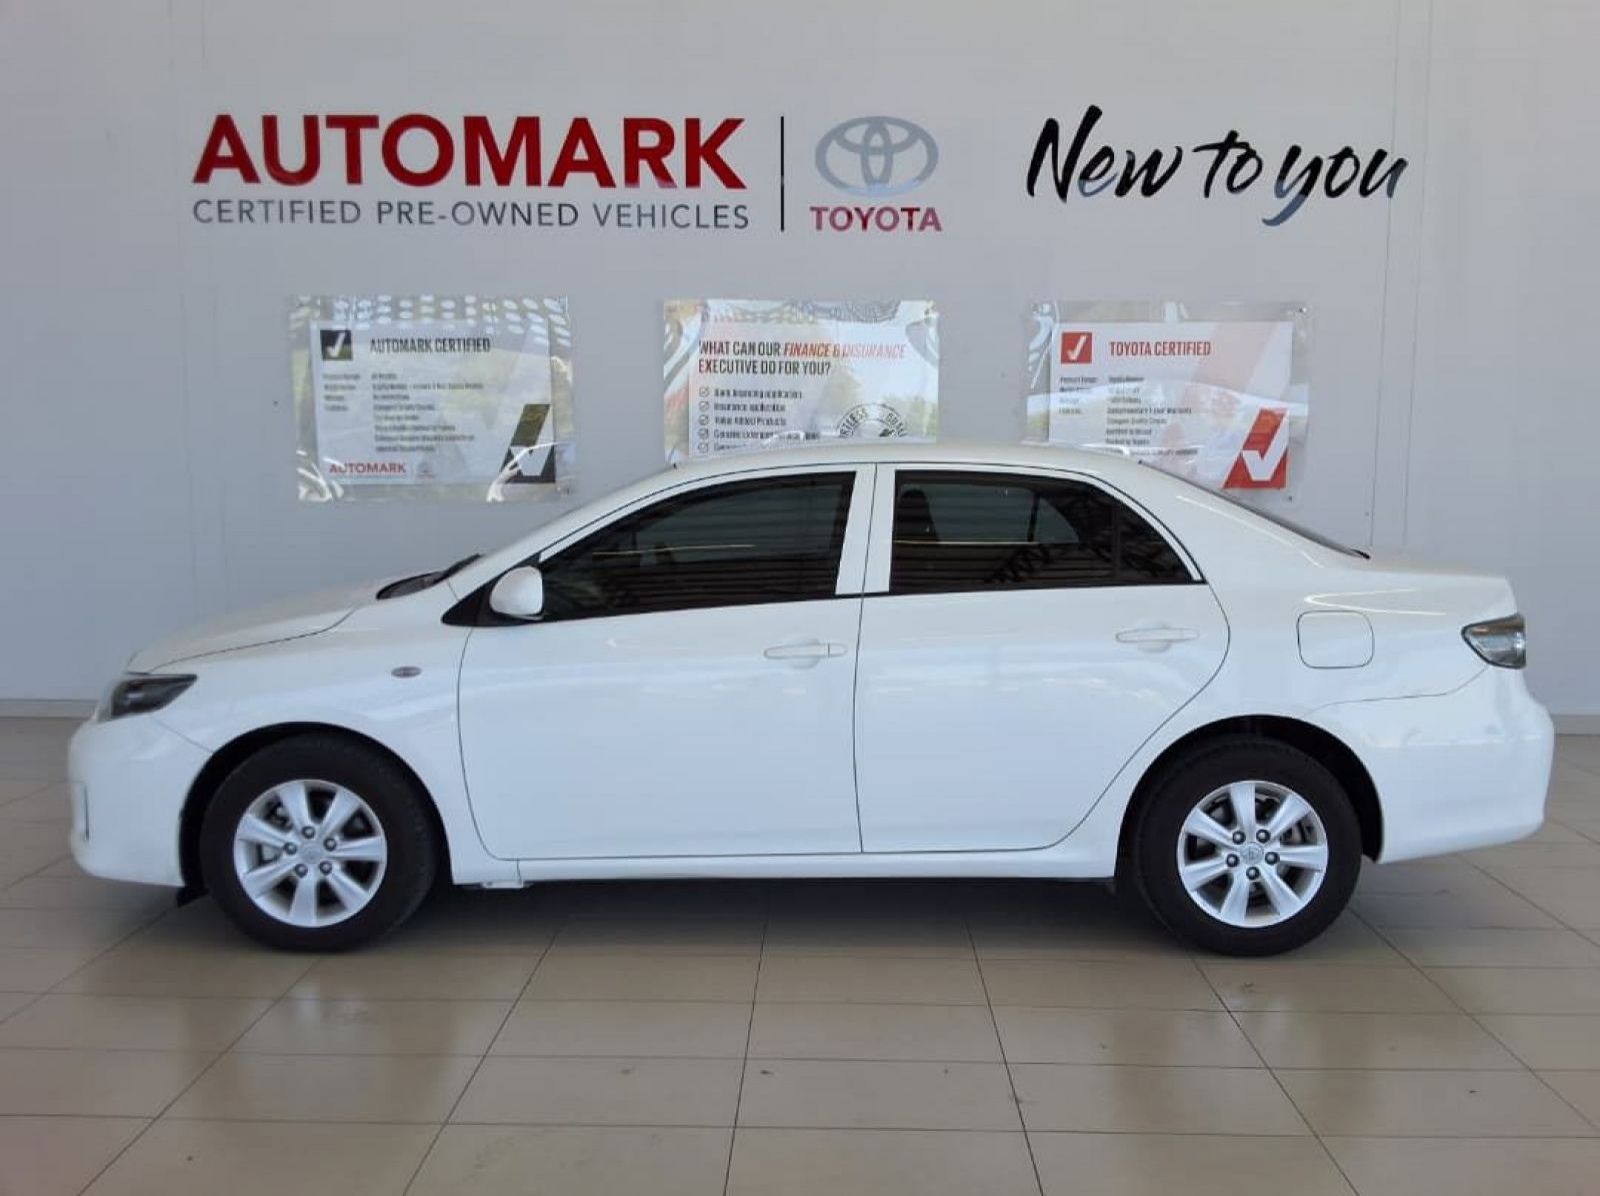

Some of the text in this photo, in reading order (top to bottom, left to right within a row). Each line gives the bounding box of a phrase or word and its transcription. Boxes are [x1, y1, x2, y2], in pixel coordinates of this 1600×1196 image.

[192, 114, 747, 189] AUTOMARK
[1026, 104, 1409, 226] New to you
[192, 200, 750, 229] CERTIFIED PRE-OWNED VEHICLES
[809, 206, 942, 232] TOYOTA
[370, 337, 491, 353] AUTOMARK CERTIFIED
[699, 341, 730, 355] WHAT
[732, 341, 757, 356] CAN
[758, 342, 780, 356] OUR
[783, 343, 831, 358] FINANCE
[1109, 341, 1211, 356] TOYOTA CERTIFIED
[698, 359, 831, 375] EXECUTIVE DO FOR YOU?
[329, 462, 406, 474] AUTOMARK
